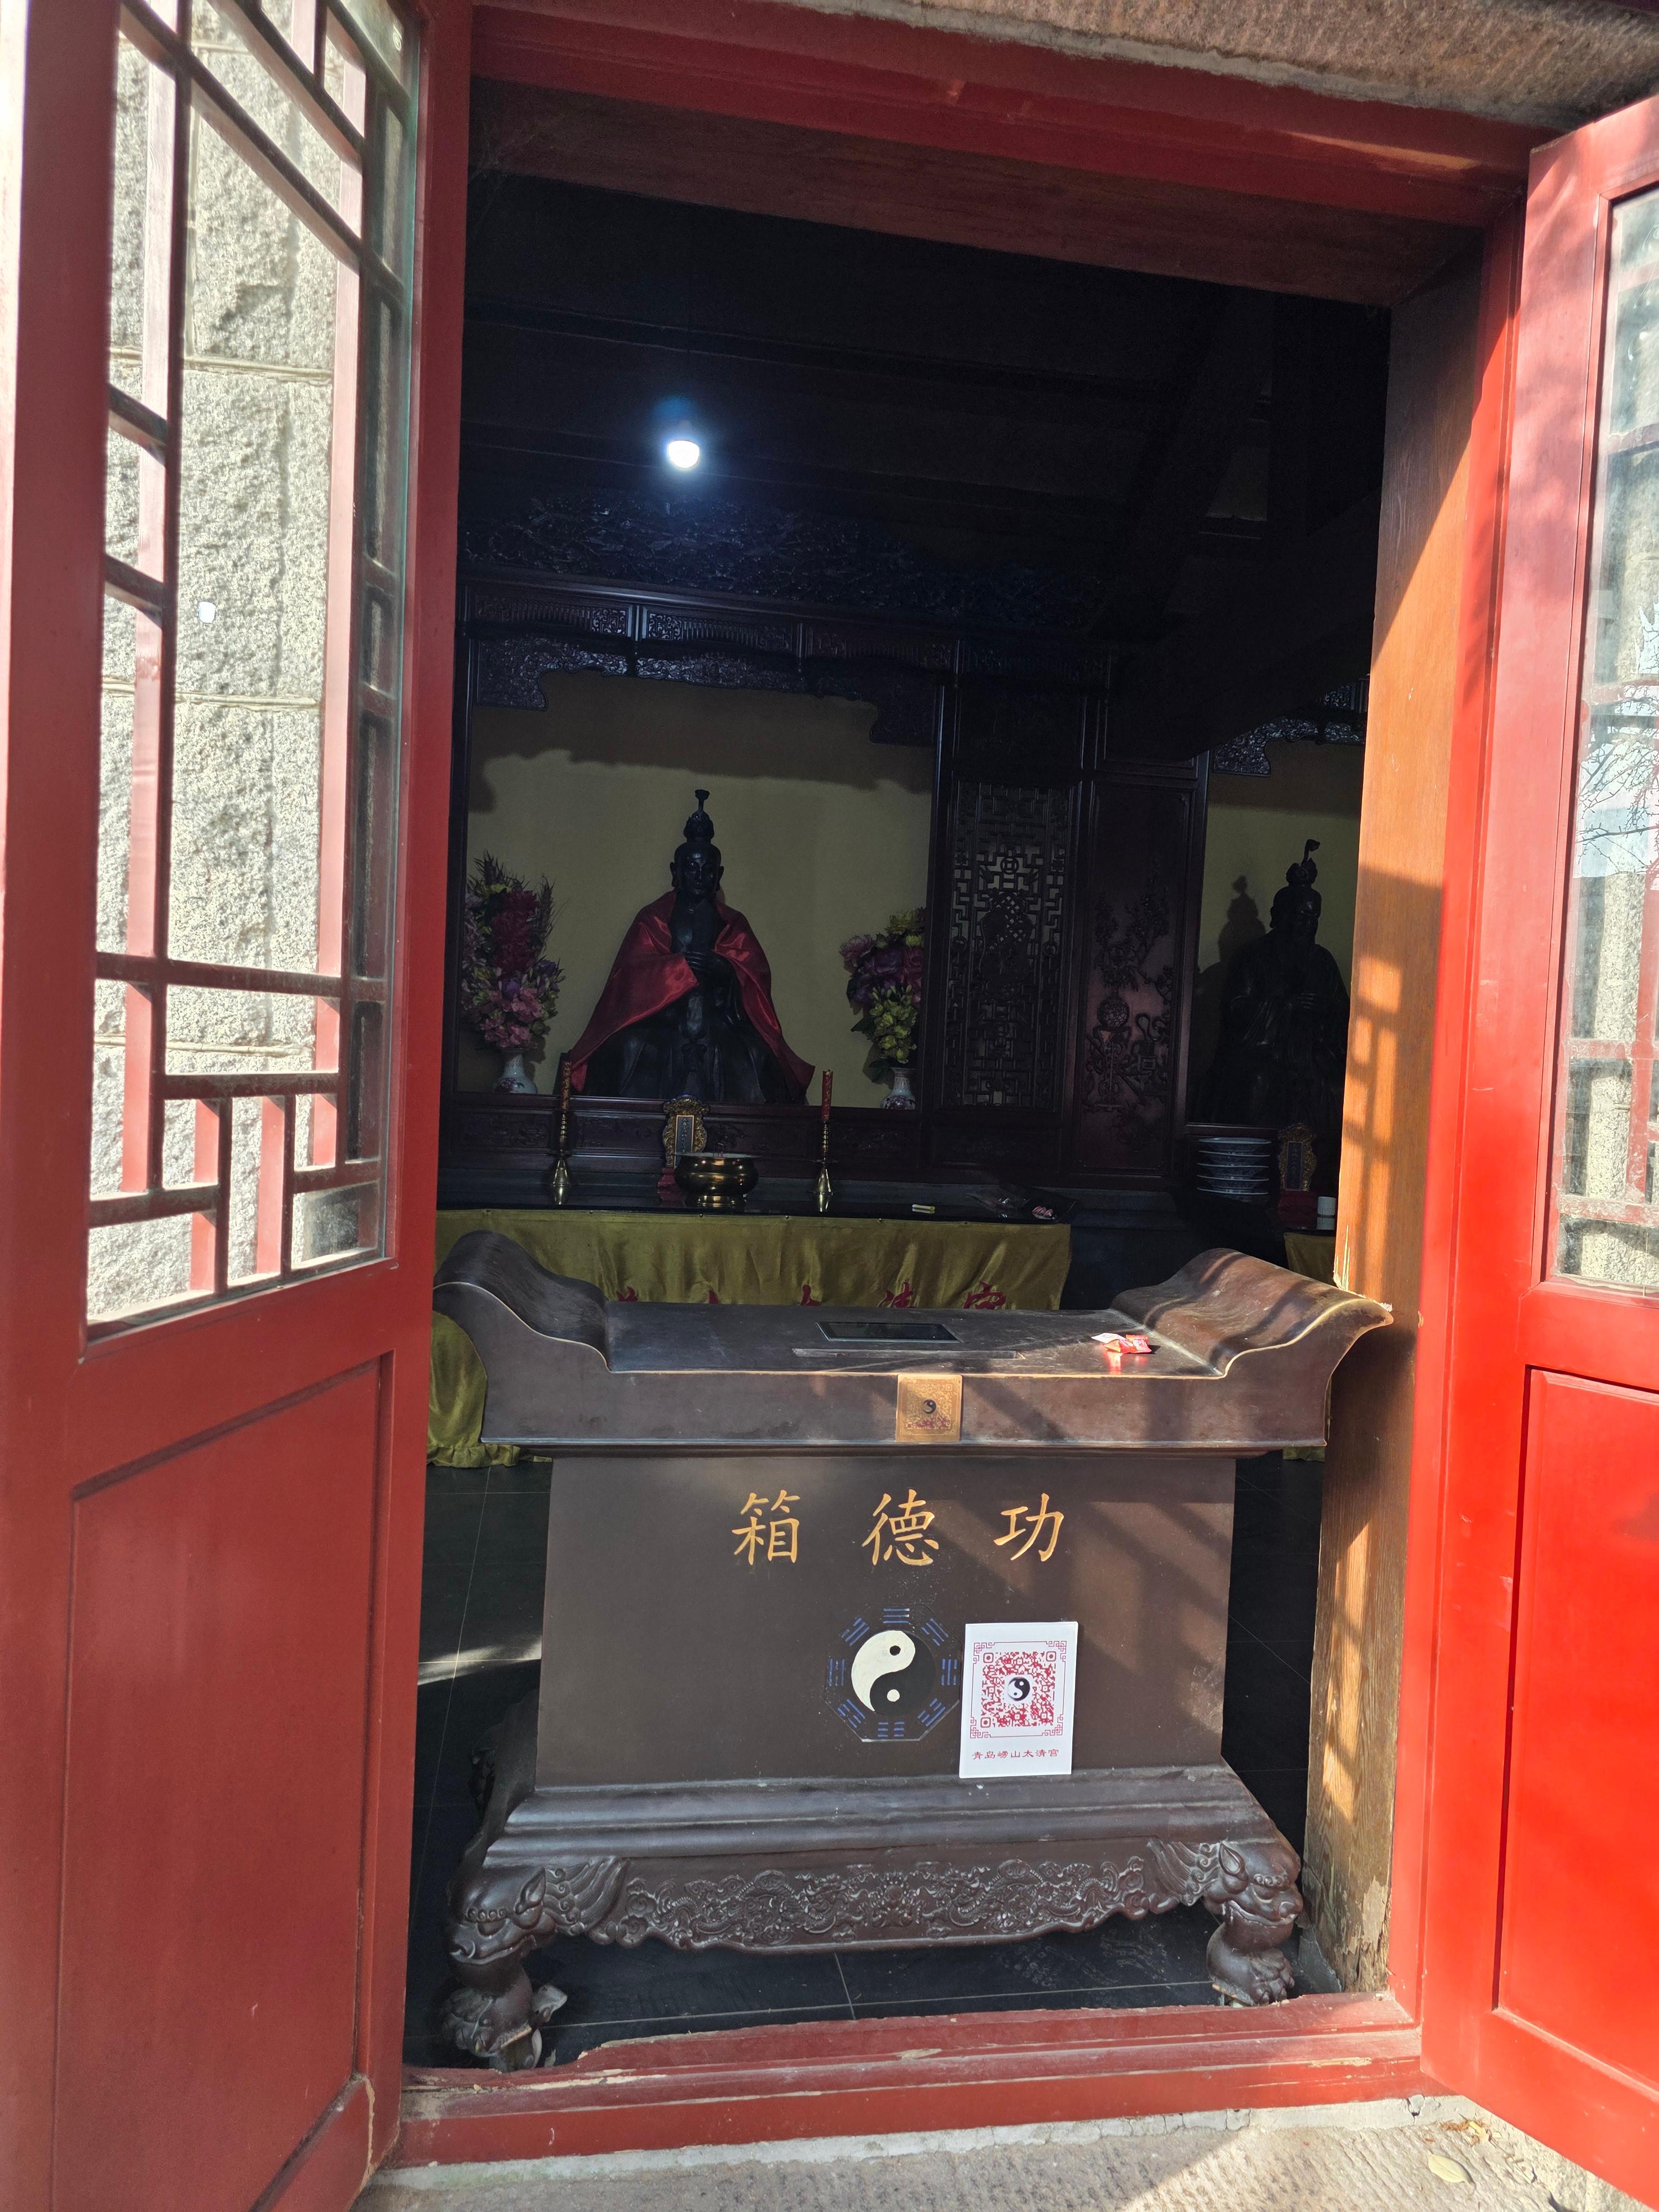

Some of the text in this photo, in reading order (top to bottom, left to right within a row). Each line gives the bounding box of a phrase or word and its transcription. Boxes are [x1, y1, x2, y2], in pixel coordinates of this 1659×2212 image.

[972, 1749, 1059, 1760] 青岛崂山太清宫
